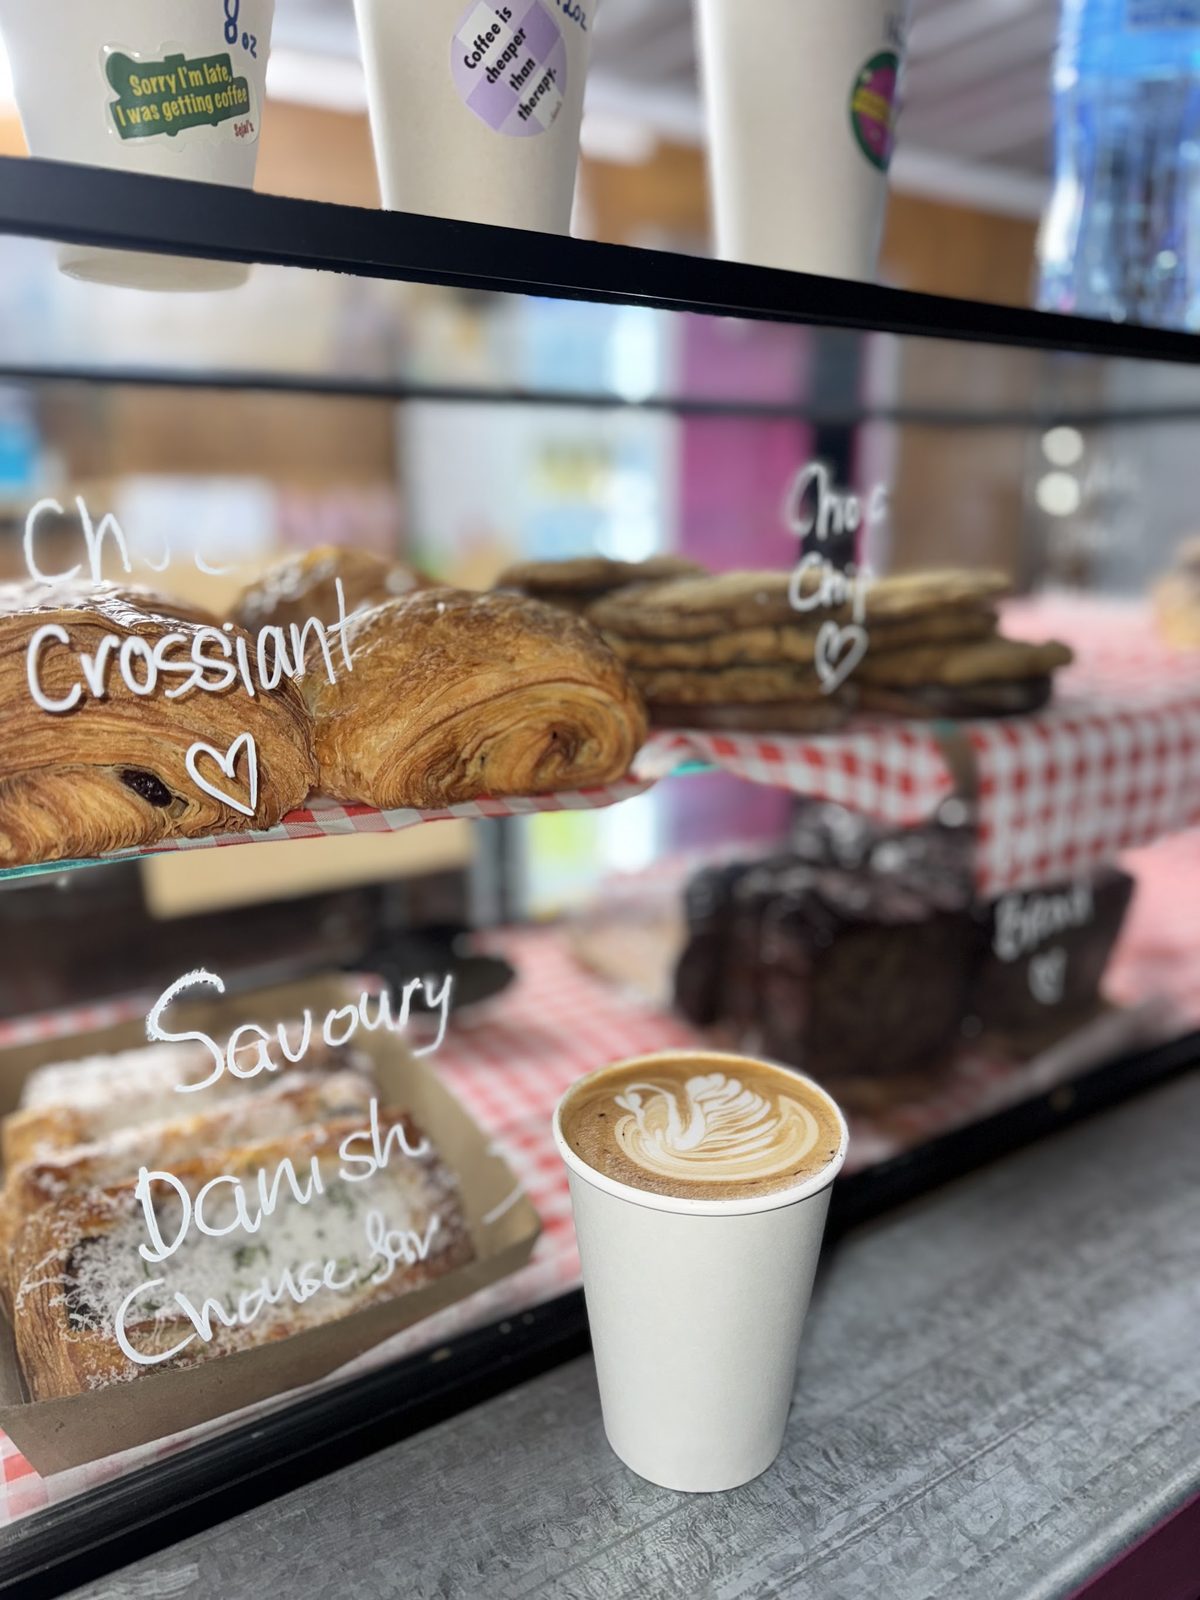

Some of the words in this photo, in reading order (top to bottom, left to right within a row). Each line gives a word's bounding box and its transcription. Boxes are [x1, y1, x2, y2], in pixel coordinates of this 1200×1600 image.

[464, 23, 501, 70] Coffee
[495, 6, 512, 24] is
[486, 27, 526, 84] cheaper
[129, 73, 176, 96] Sorry
[177, 66, 203, 88] I'm
[204, 63, 232, 83] late,
[509, 57, 536, 91] than
[517, 67, 557, 121] therapy.
[116, 105, 126, 126] I
[127, 104, 160, 124] was
[162, 93, 214, 121] getting
[214, 85, 247, 108] coffee
[27, 576, 353, 712] Crossiant
[145, 968, 453, 1093] Savoury
[134, 1097, 430, 1262] Danish
